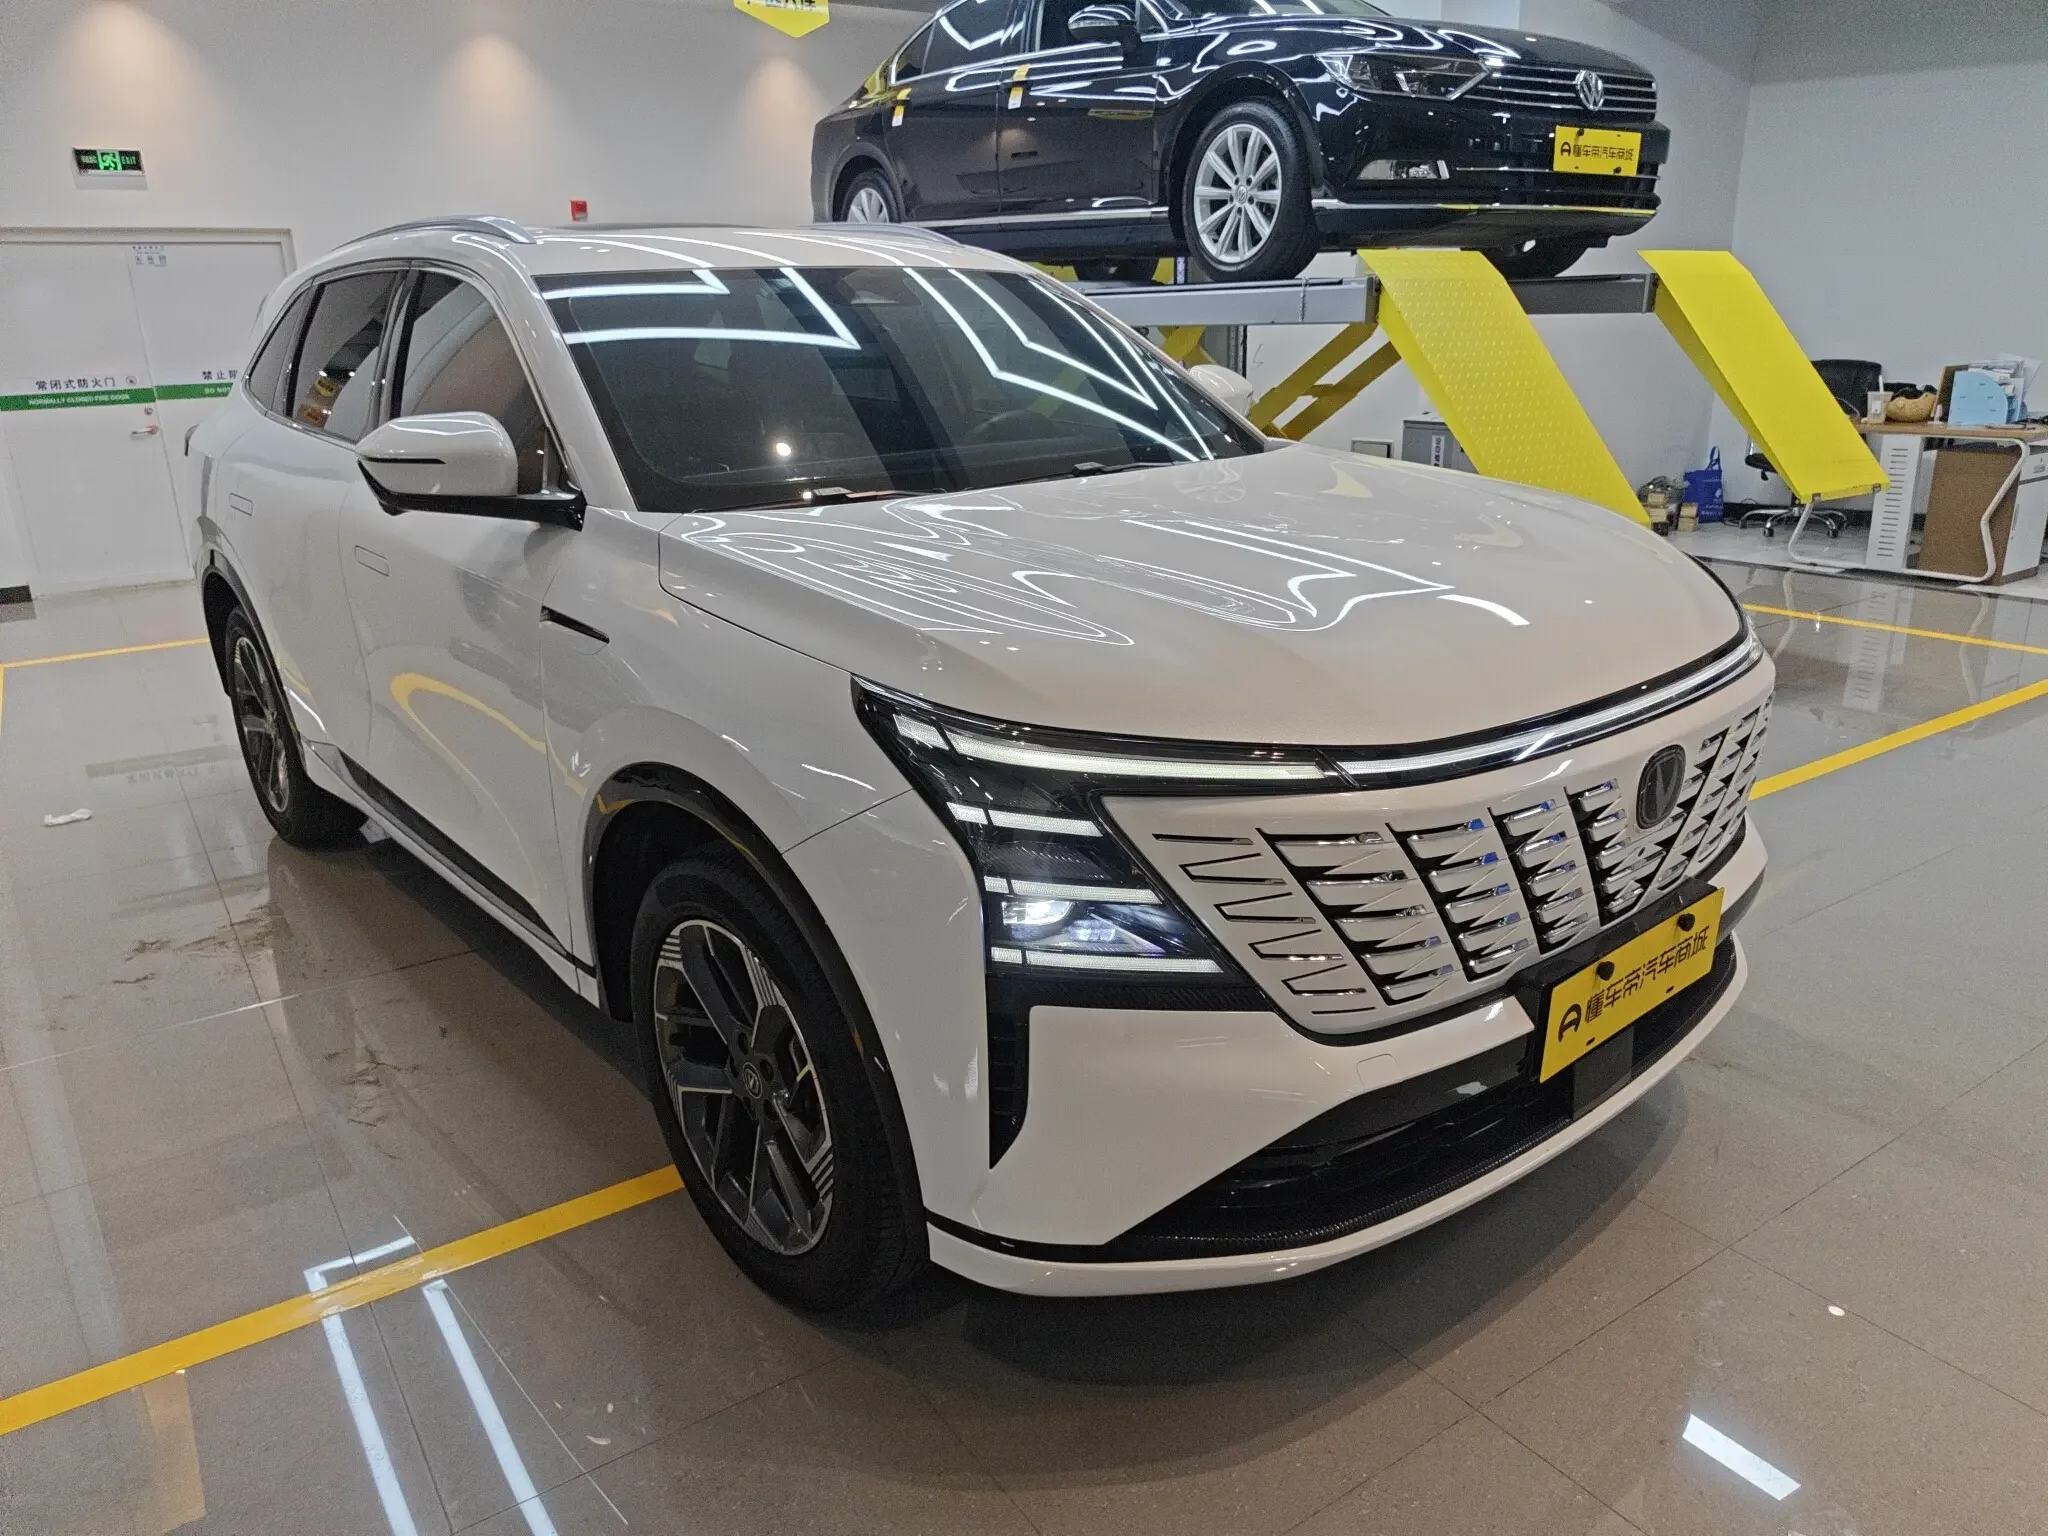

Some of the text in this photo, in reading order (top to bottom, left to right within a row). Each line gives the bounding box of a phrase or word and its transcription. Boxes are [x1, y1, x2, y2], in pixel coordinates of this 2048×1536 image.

[36, 376, 116, 391] 常闭式防火门
[1585, 924, 1710, 1024] 懂车帝汽车商城
